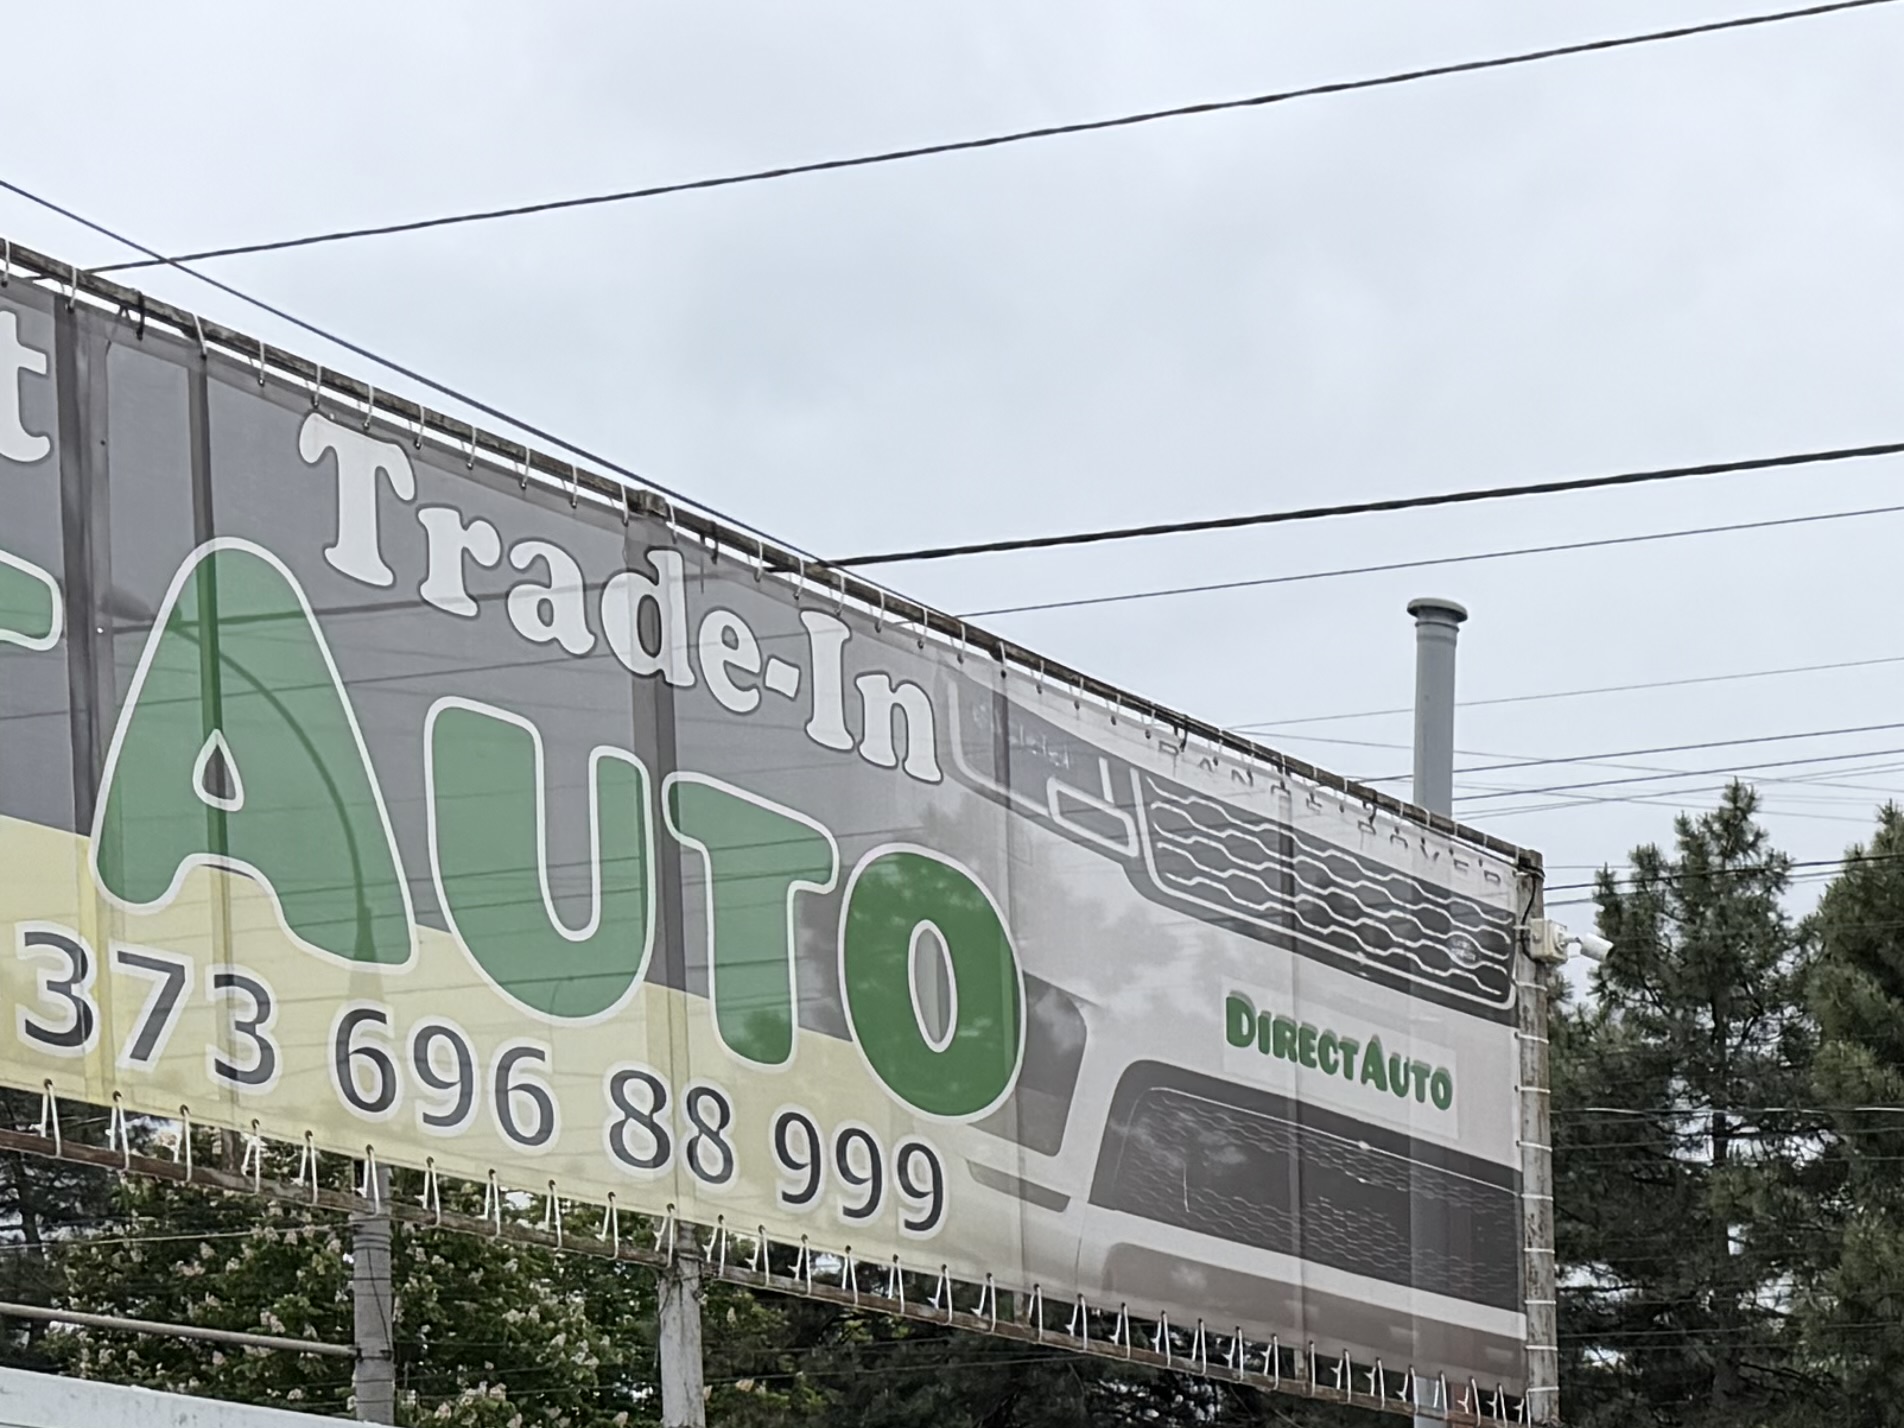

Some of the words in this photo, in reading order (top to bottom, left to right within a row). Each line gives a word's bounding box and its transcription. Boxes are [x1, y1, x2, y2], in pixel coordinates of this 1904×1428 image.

[298, 411, 944, 785] Trade-In
[0, 537, 1027, 1123] AUTO
[23, 929, 277, 1084] 373
[332, 1006, 556, 1149] 696
[607, 1068, 734, 1186] 88
[774, 1109, 945, 1234] 999
[1226, 989, 1455, 1111] DIRECTAUTO
